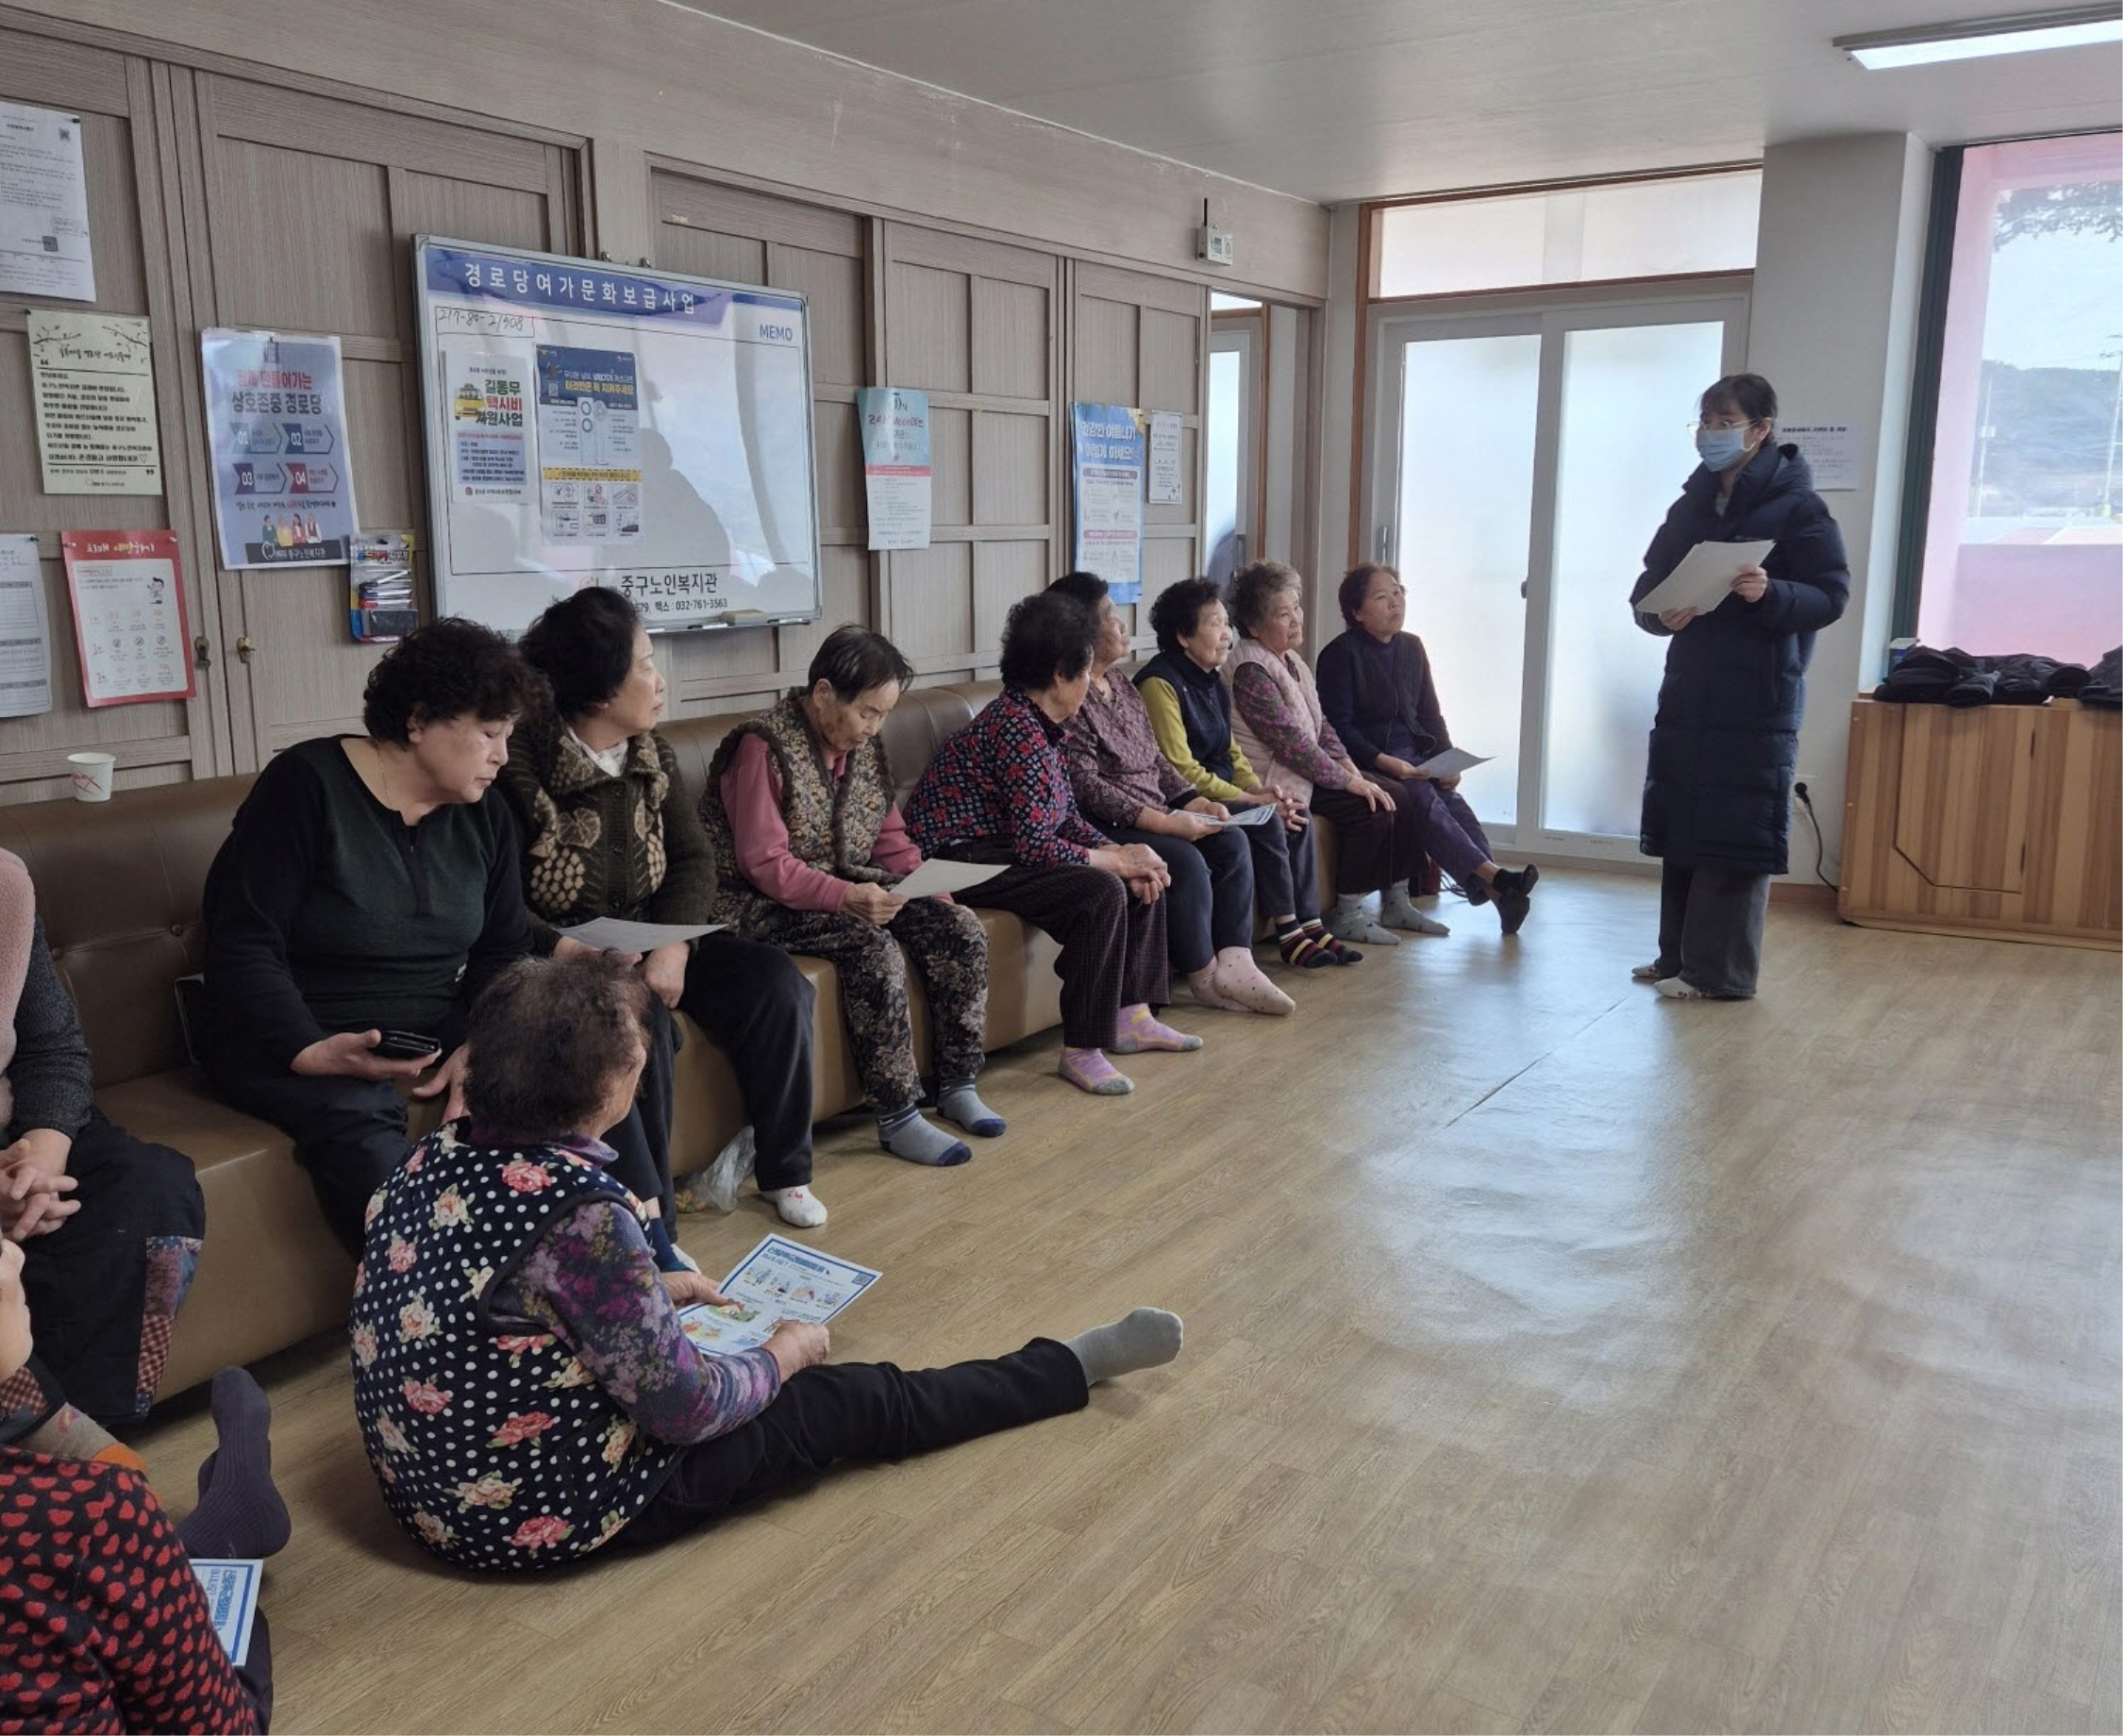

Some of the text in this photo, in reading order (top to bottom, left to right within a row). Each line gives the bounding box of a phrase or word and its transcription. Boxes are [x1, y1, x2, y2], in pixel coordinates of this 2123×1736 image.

[759, 323, 794, 342] MEMO
[484, 379, 521, 395] 길동무
[232, 391, 322, 415] 상호존중 경로당
[485, 396, 523, 411] 택시비
[476, 410, 523, 427] 지원사업
[291, 432, 302, 446] 02
[242, 473, 253, 486] 03
[294, 473, 307, 485] 04
[620, 572, 718, 597] 중구노인복지관
[676, 597, 728, 610] 032-761-3563
